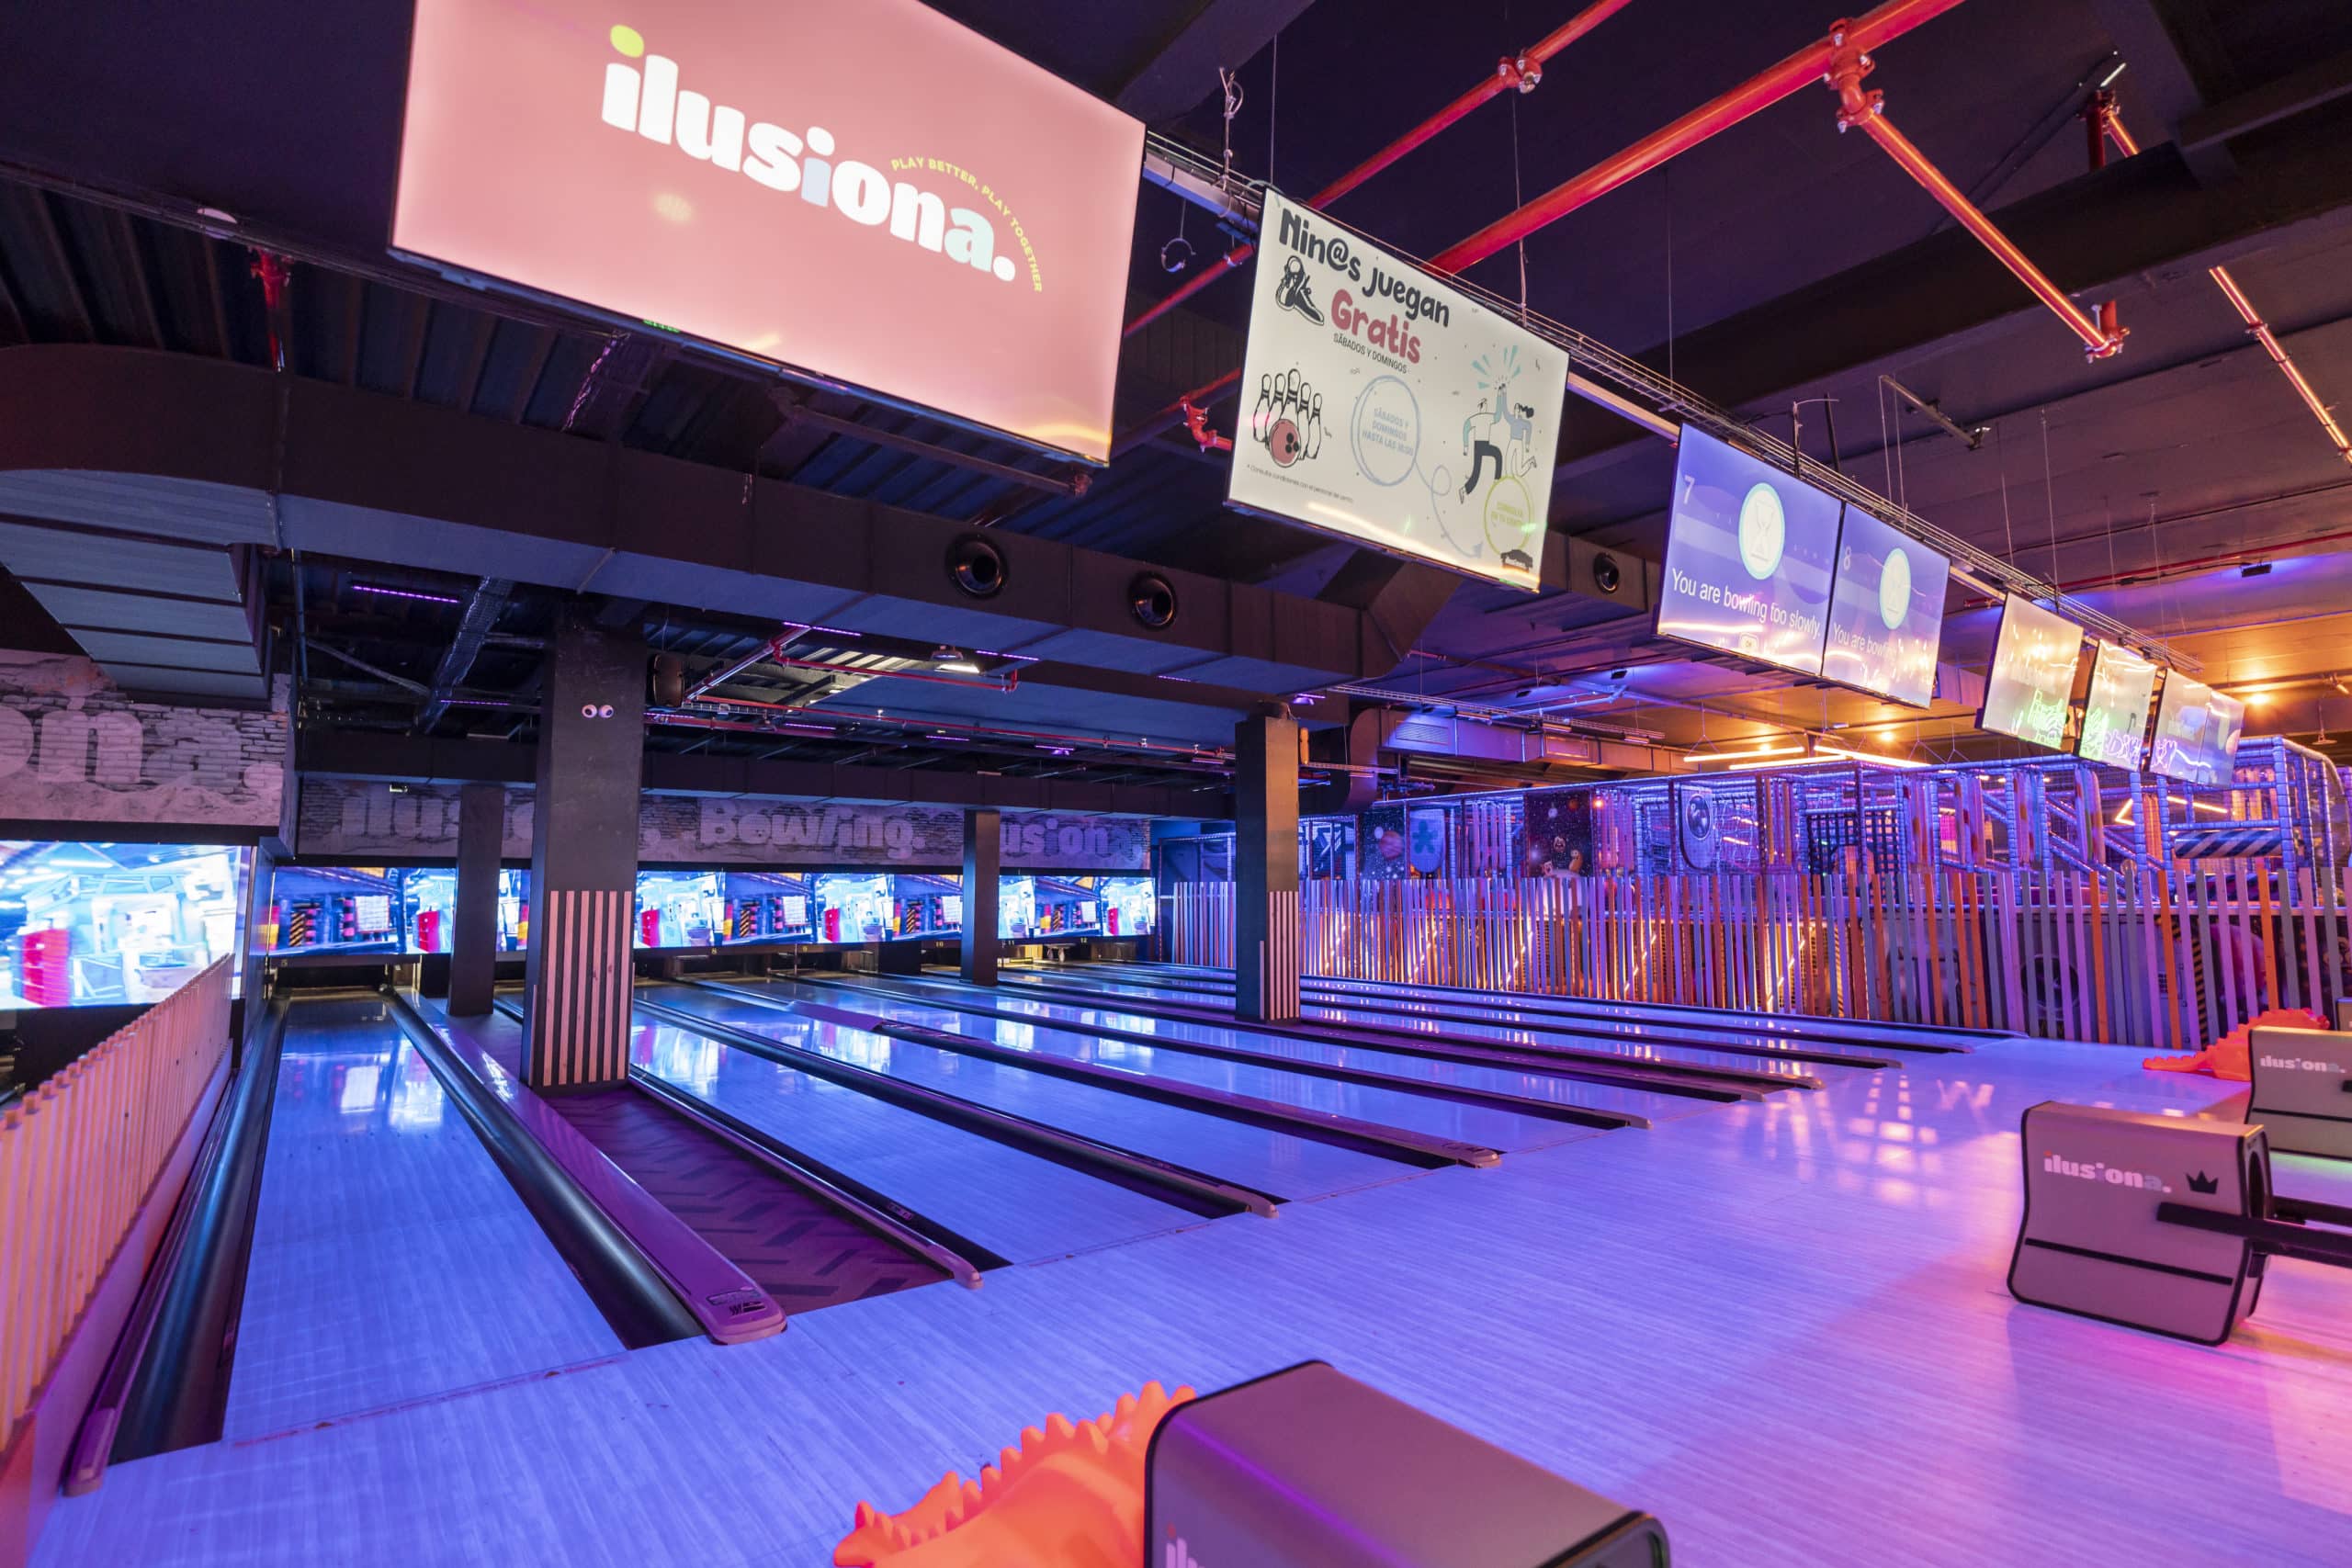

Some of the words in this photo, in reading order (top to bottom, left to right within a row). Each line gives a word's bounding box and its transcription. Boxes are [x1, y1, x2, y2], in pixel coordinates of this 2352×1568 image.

[601, 24, 1016, 282] ilusiona.
[890, 156, 924, 172] PLAY
[928, 158, 978, 190] BETTER,
[981, 185, 1011, 217] PLAY
[1011, 217, 1043, 293] TOGETHER
[1279, 208, 1362, 282] Nin@s
[1362, 267, 1450, 328] juegan
[1331, 288, 1421, 364] Gratis
[1372, 350, 1408, 374] DOMINGOS
[1683, 474, 1695, 505] 7
[1843, 546, 1852, 571] 8
[1672, 568, 1697, 596] You
[1700, 583, 1721, 604] are
[1724, 585, 1768, 624] bowling
[1770, 603, 1787, 625] too
[1790, 609, 1821, 640] slowly.
[1833, 622, 1849, 646] You
[1851, 633, 1866, 651] are
[2043, 1150, 2172, 1193] ilusiona.
